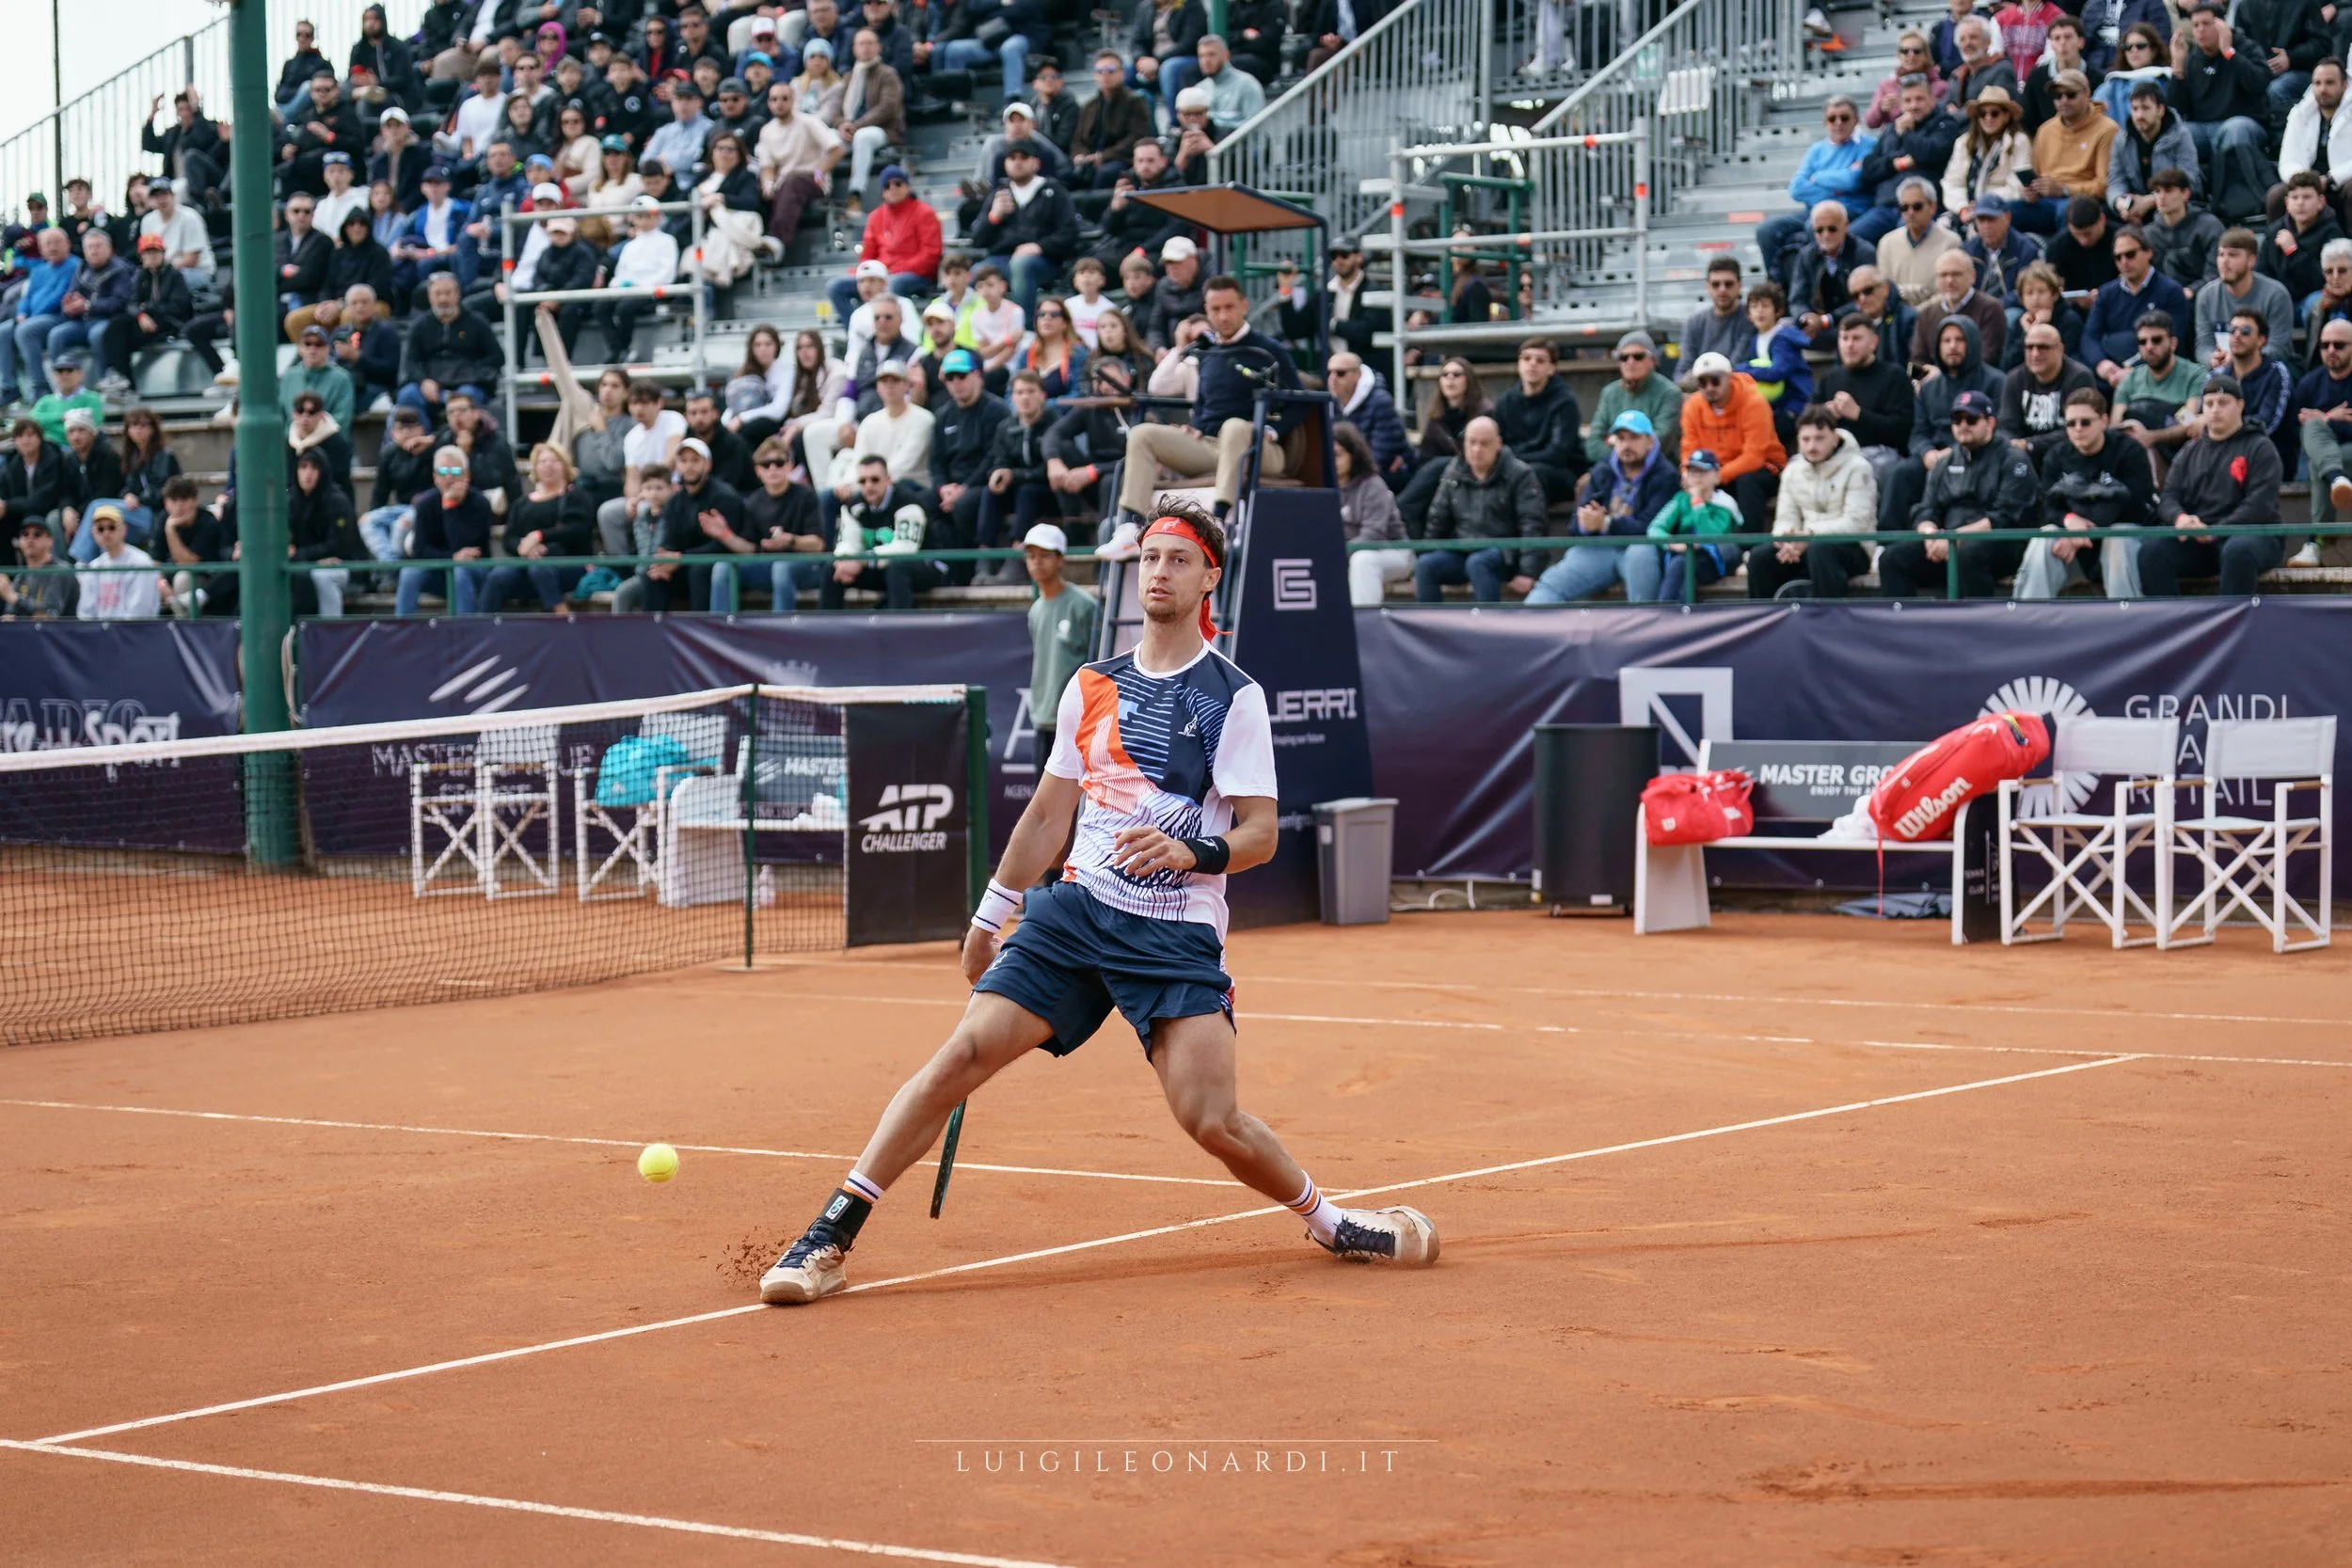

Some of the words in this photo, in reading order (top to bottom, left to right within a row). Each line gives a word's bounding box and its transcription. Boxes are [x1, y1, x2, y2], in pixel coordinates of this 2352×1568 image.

[1268, 689, 1358, 722] UERRI
[2125, 694, 2287, 725] GRANDI
[1759, 764, 1845, 786] MASTER
[2129, 774, 2273, 806] RTAIL
[858, 784, 954, 832] ATP
[1894, 777, 1972, 839] Wilson
[861, 832, 947, 853] CHALLENGER
